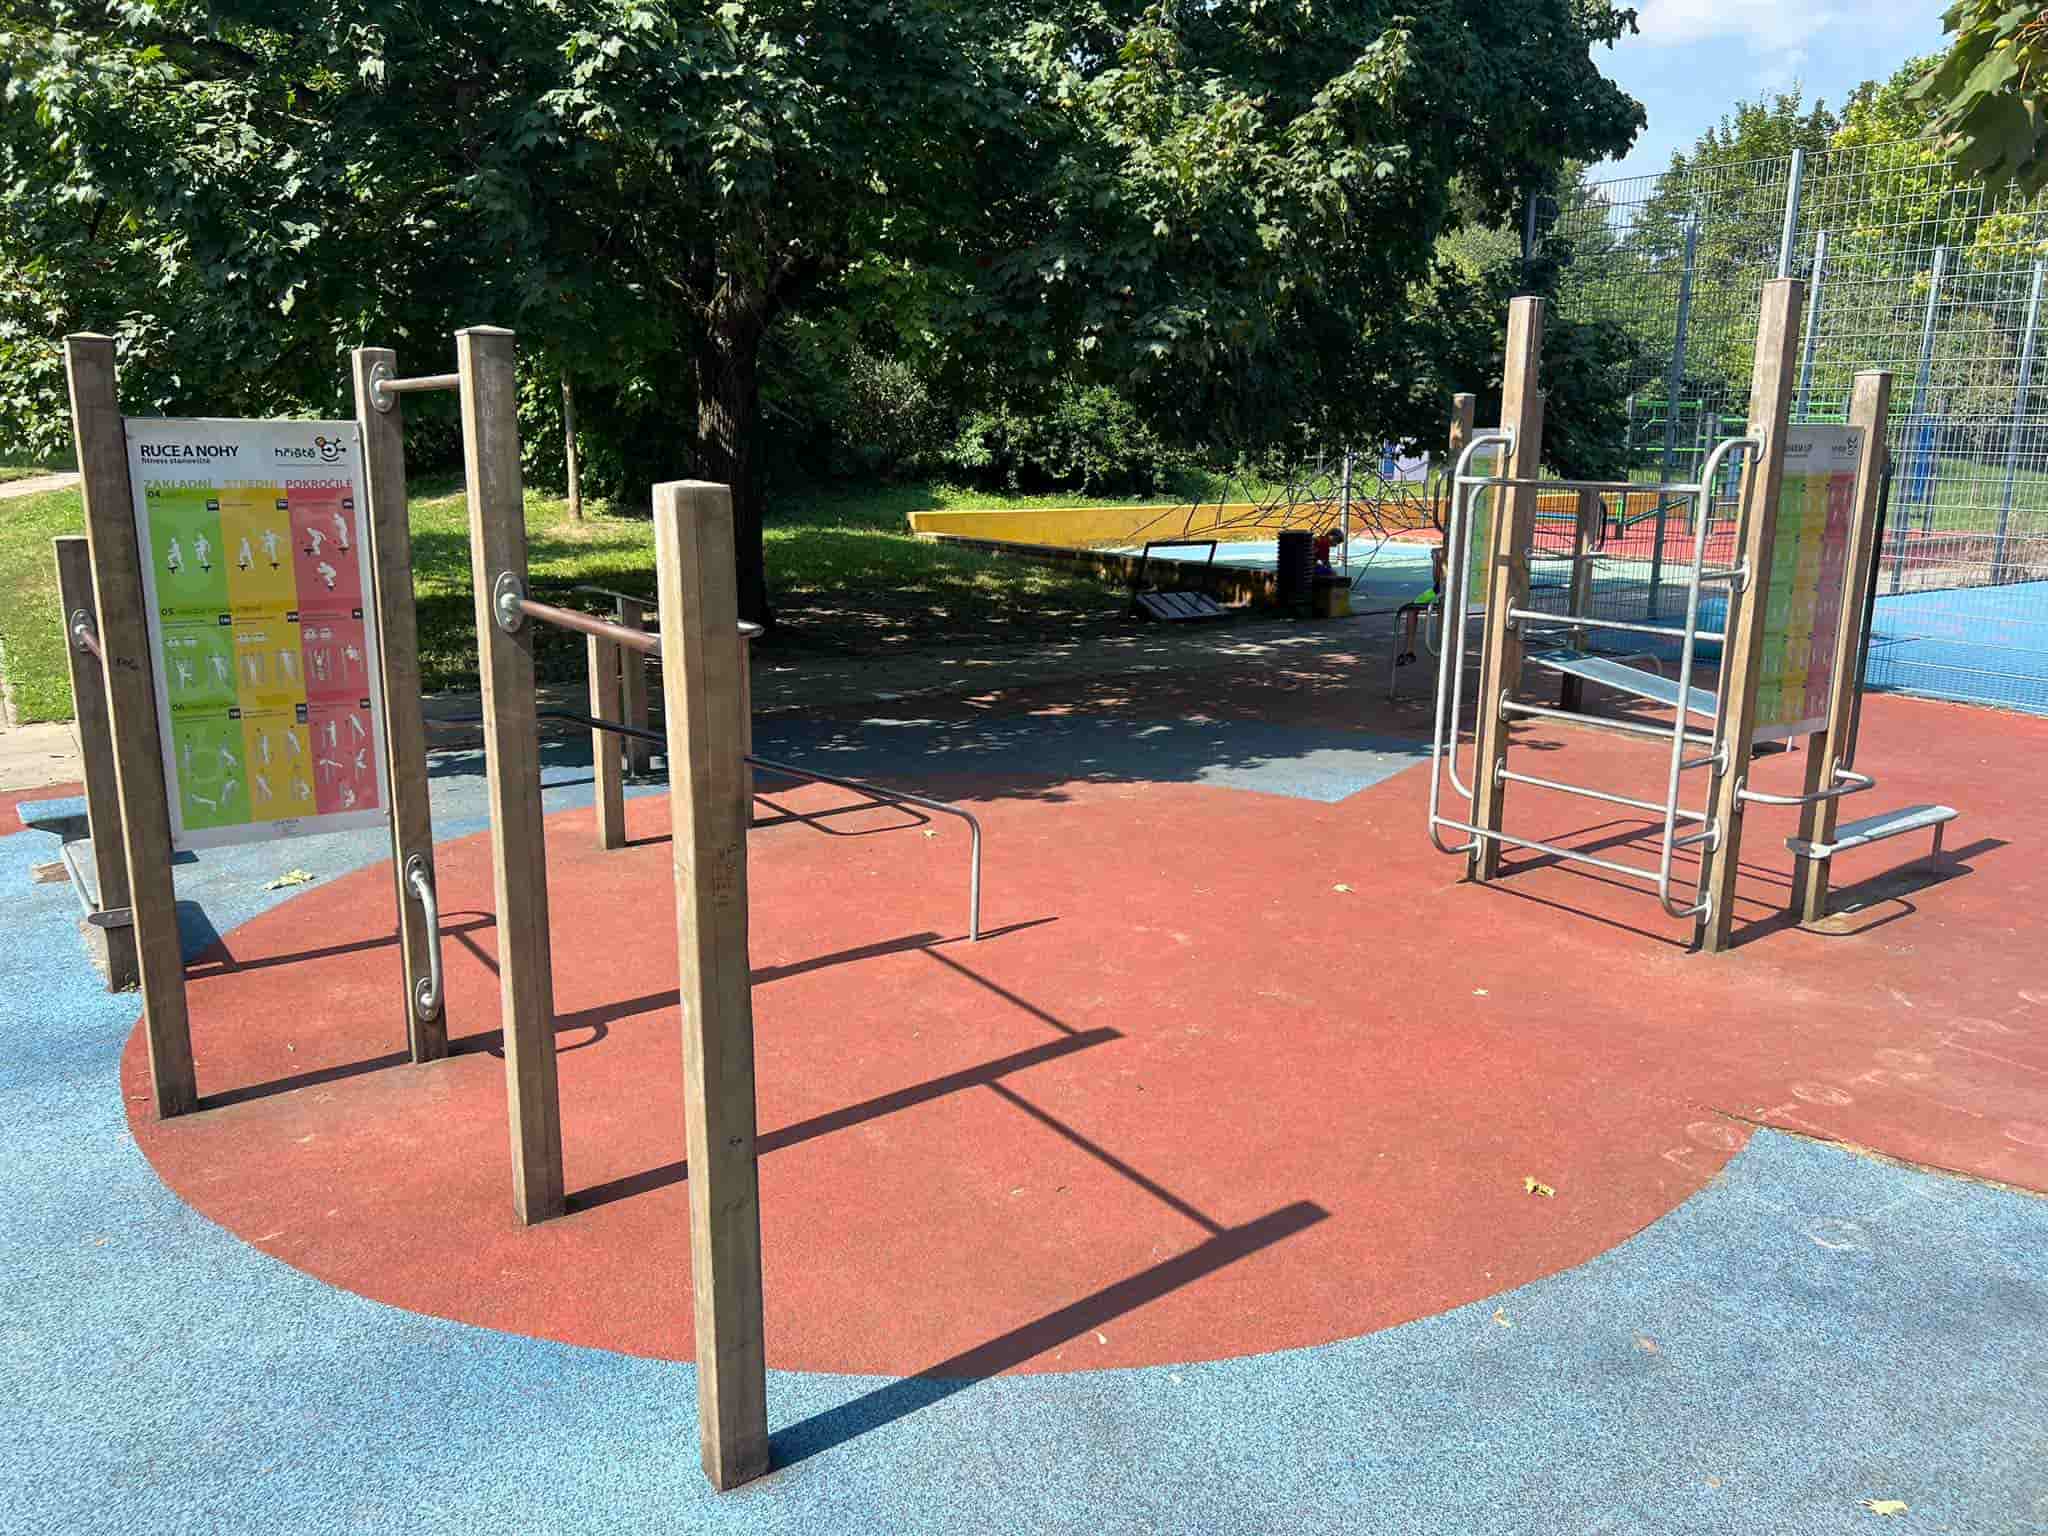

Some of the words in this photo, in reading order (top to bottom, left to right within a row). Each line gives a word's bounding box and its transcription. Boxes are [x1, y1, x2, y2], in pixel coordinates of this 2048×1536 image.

[140, 445, 181, 457] RUCE
[183, 445, 194, 457] A
[196, 445, 239, 457] NOHY
